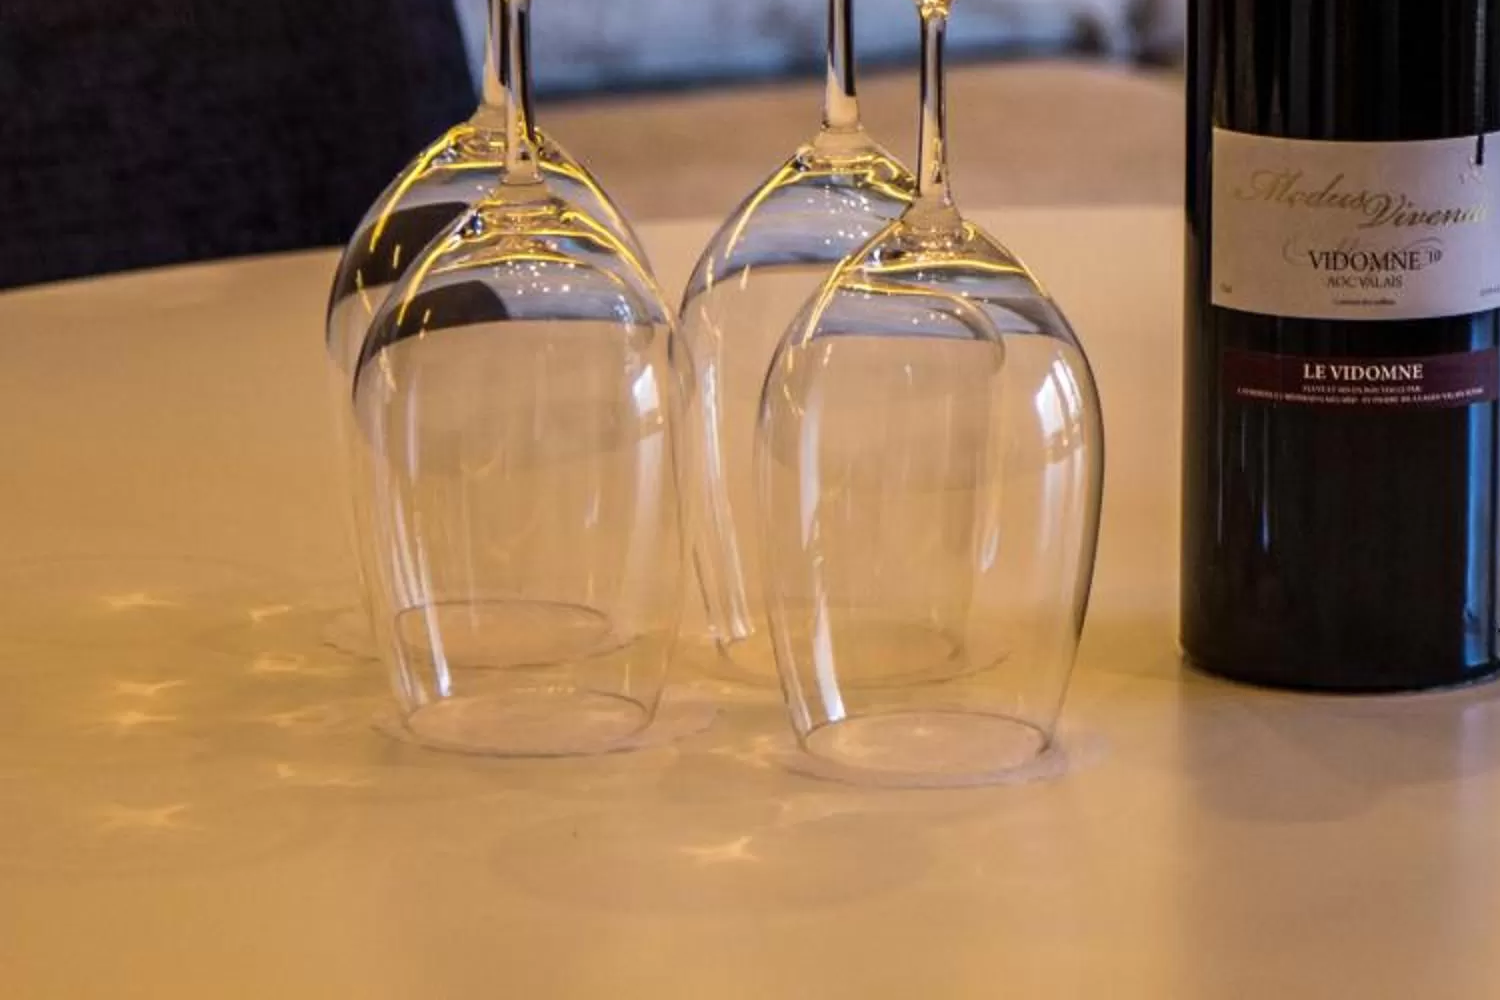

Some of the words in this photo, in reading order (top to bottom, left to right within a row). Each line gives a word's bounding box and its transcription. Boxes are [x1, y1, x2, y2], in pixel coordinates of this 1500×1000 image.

[1307, 250, 1422, 272] VIDOMNE
[1326, 275, 1357, 289] AOC
[1359, 274, 1404, 289] VALAIS
[1303, 363, 1328, 380] LE
[1330, 363, 1424, 381] VIDOMNE
